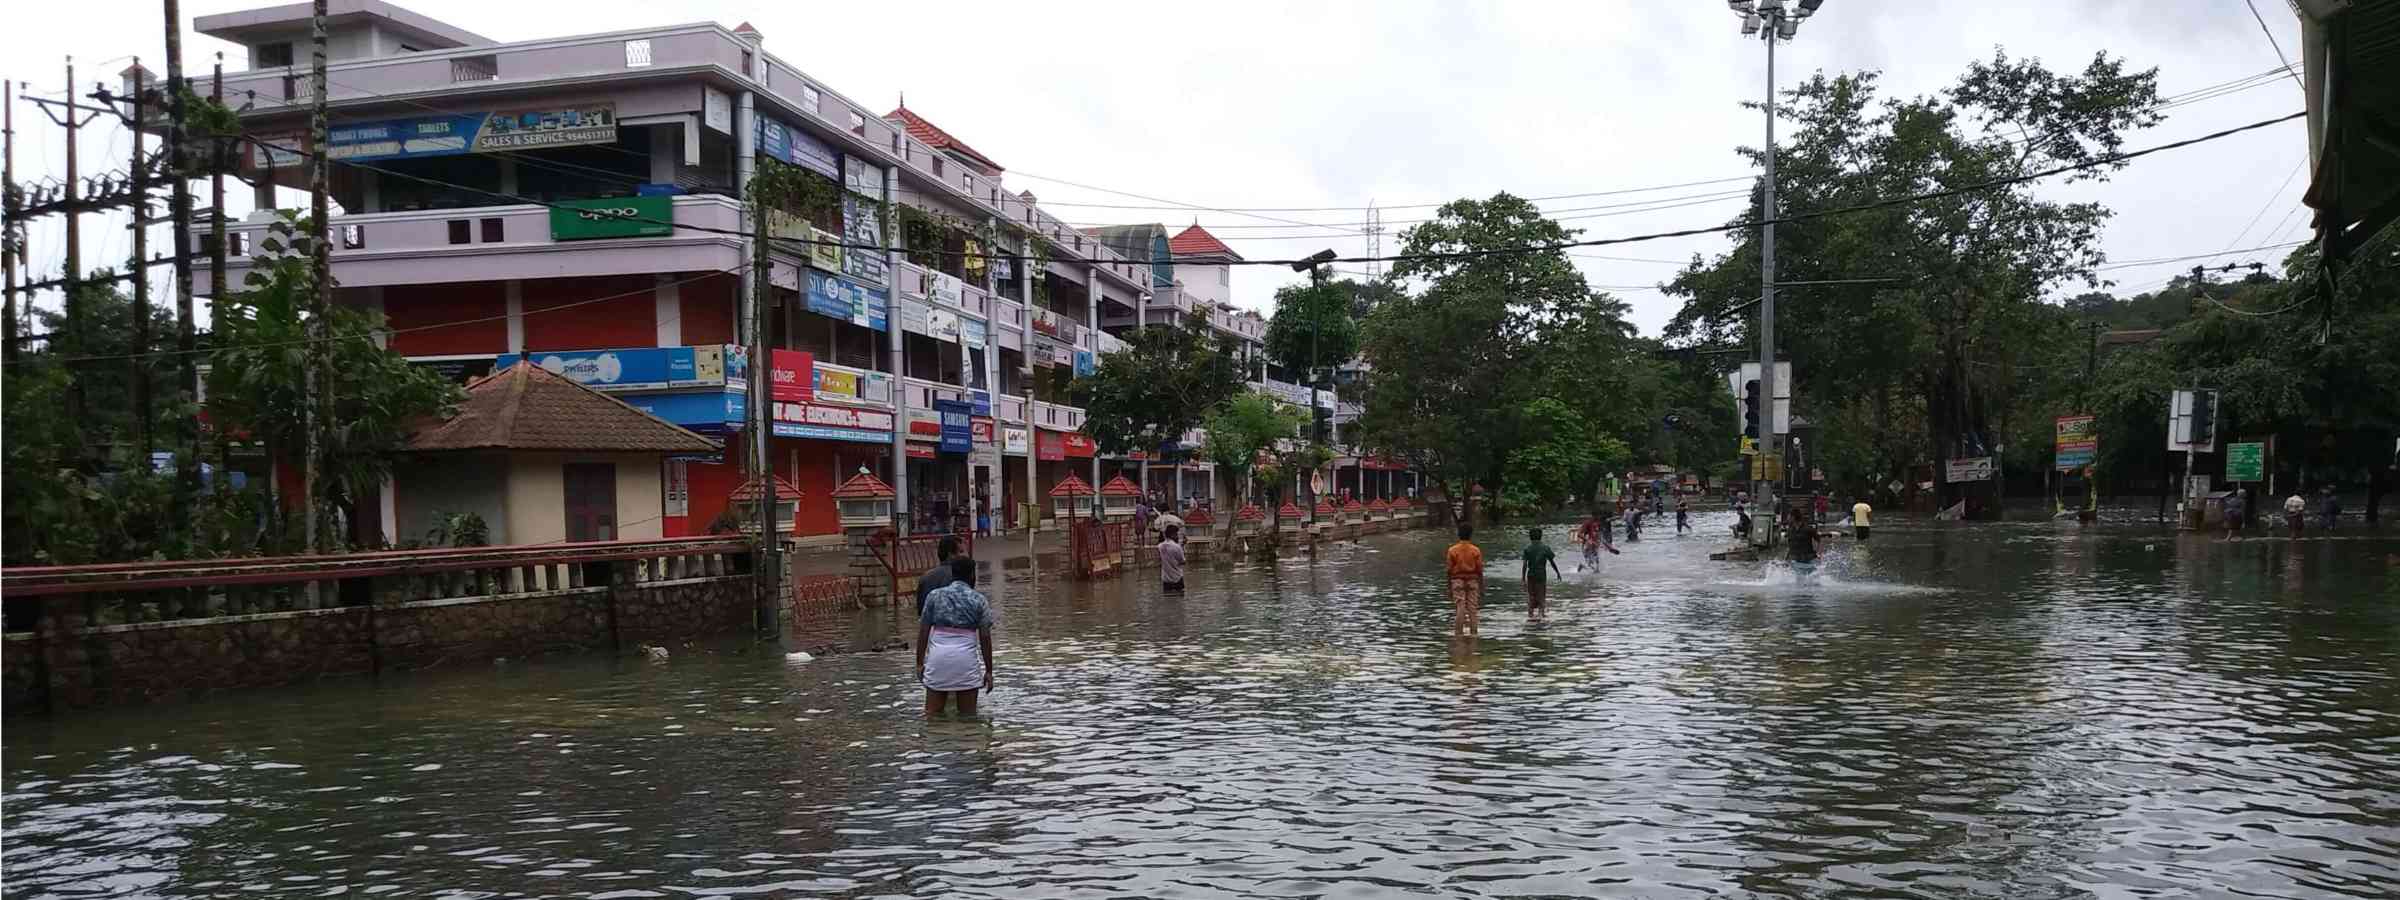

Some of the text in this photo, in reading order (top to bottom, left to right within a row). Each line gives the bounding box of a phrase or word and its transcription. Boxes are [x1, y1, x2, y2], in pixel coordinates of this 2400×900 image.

[417, 122, 449, 133] TABLETS
[481, 135, 511, 148] SALES
[523, 131, 565, 145] SERVICE
[944, 411, 969, 428] SAMSUNG
